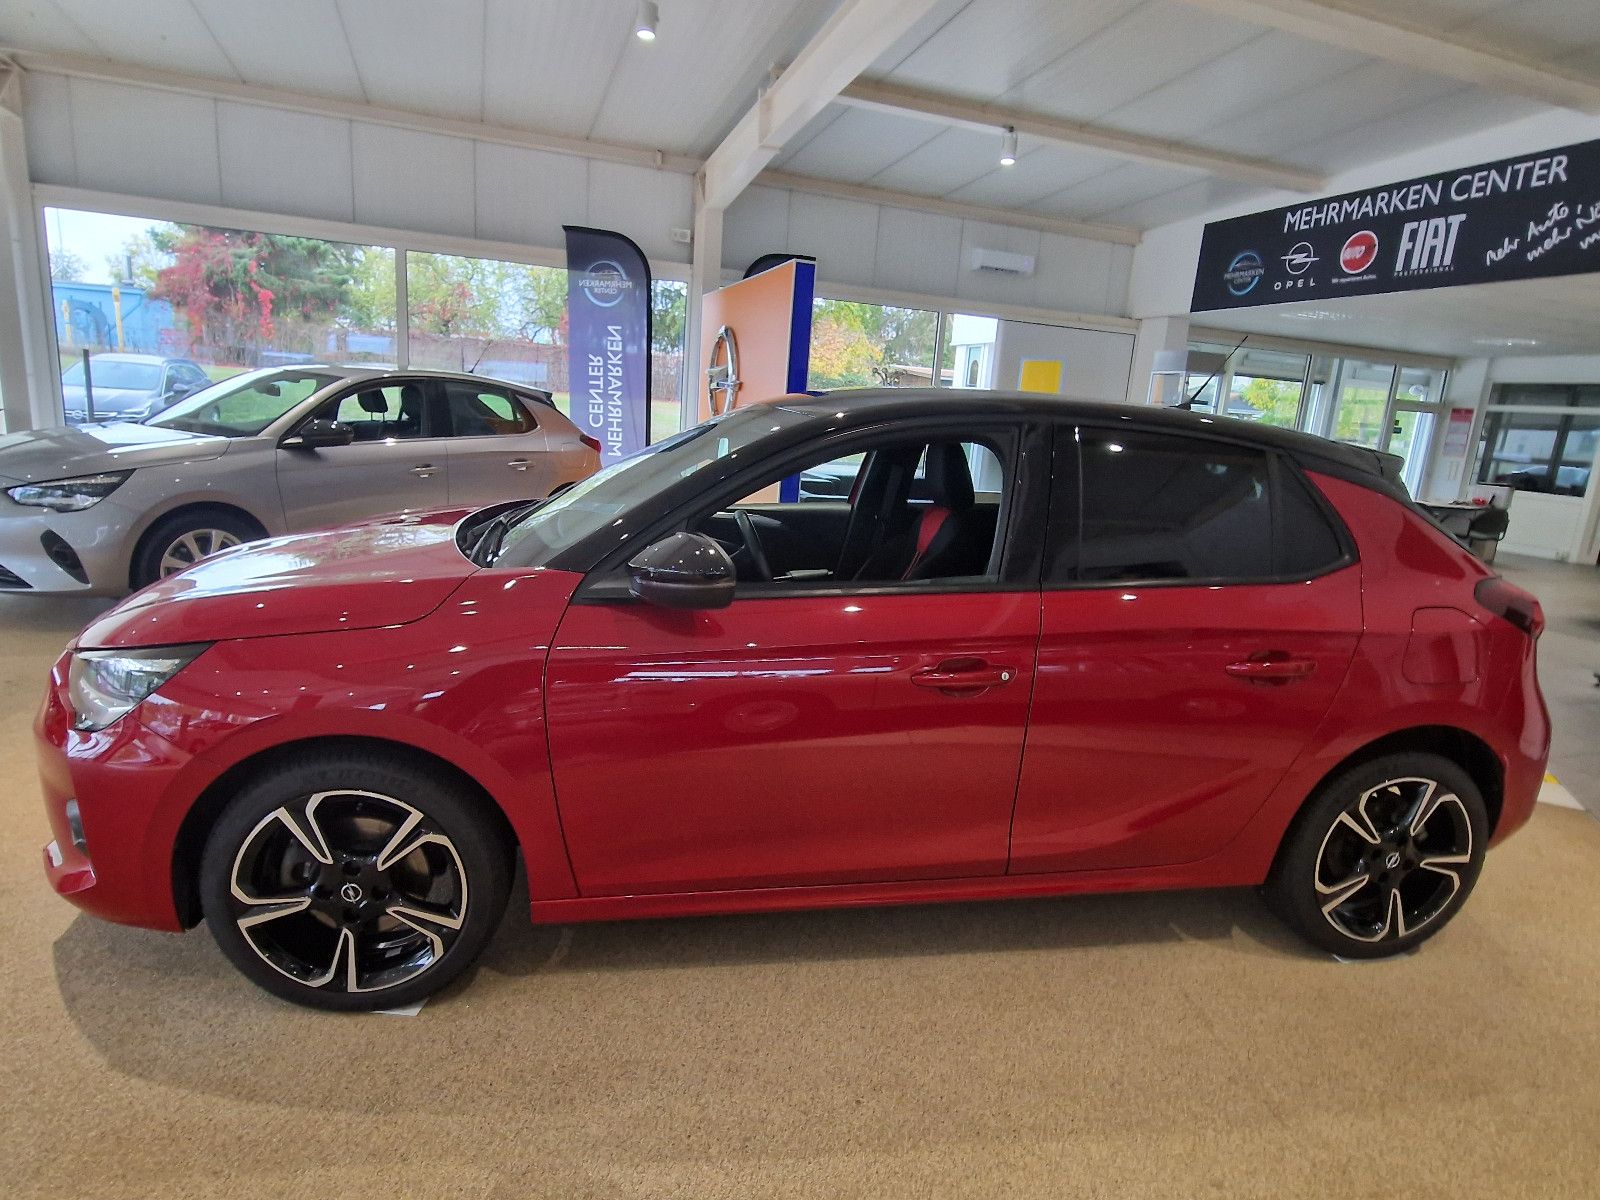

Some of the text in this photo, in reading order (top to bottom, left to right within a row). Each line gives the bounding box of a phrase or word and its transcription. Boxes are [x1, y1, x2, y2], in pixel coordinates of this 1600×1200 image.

[1283, 155, 1568, 233] MEHRMARKEN CENTER
[1395, 213, 1467, 272] FIAT
[1273, 278, 1316, 291] OPEL
